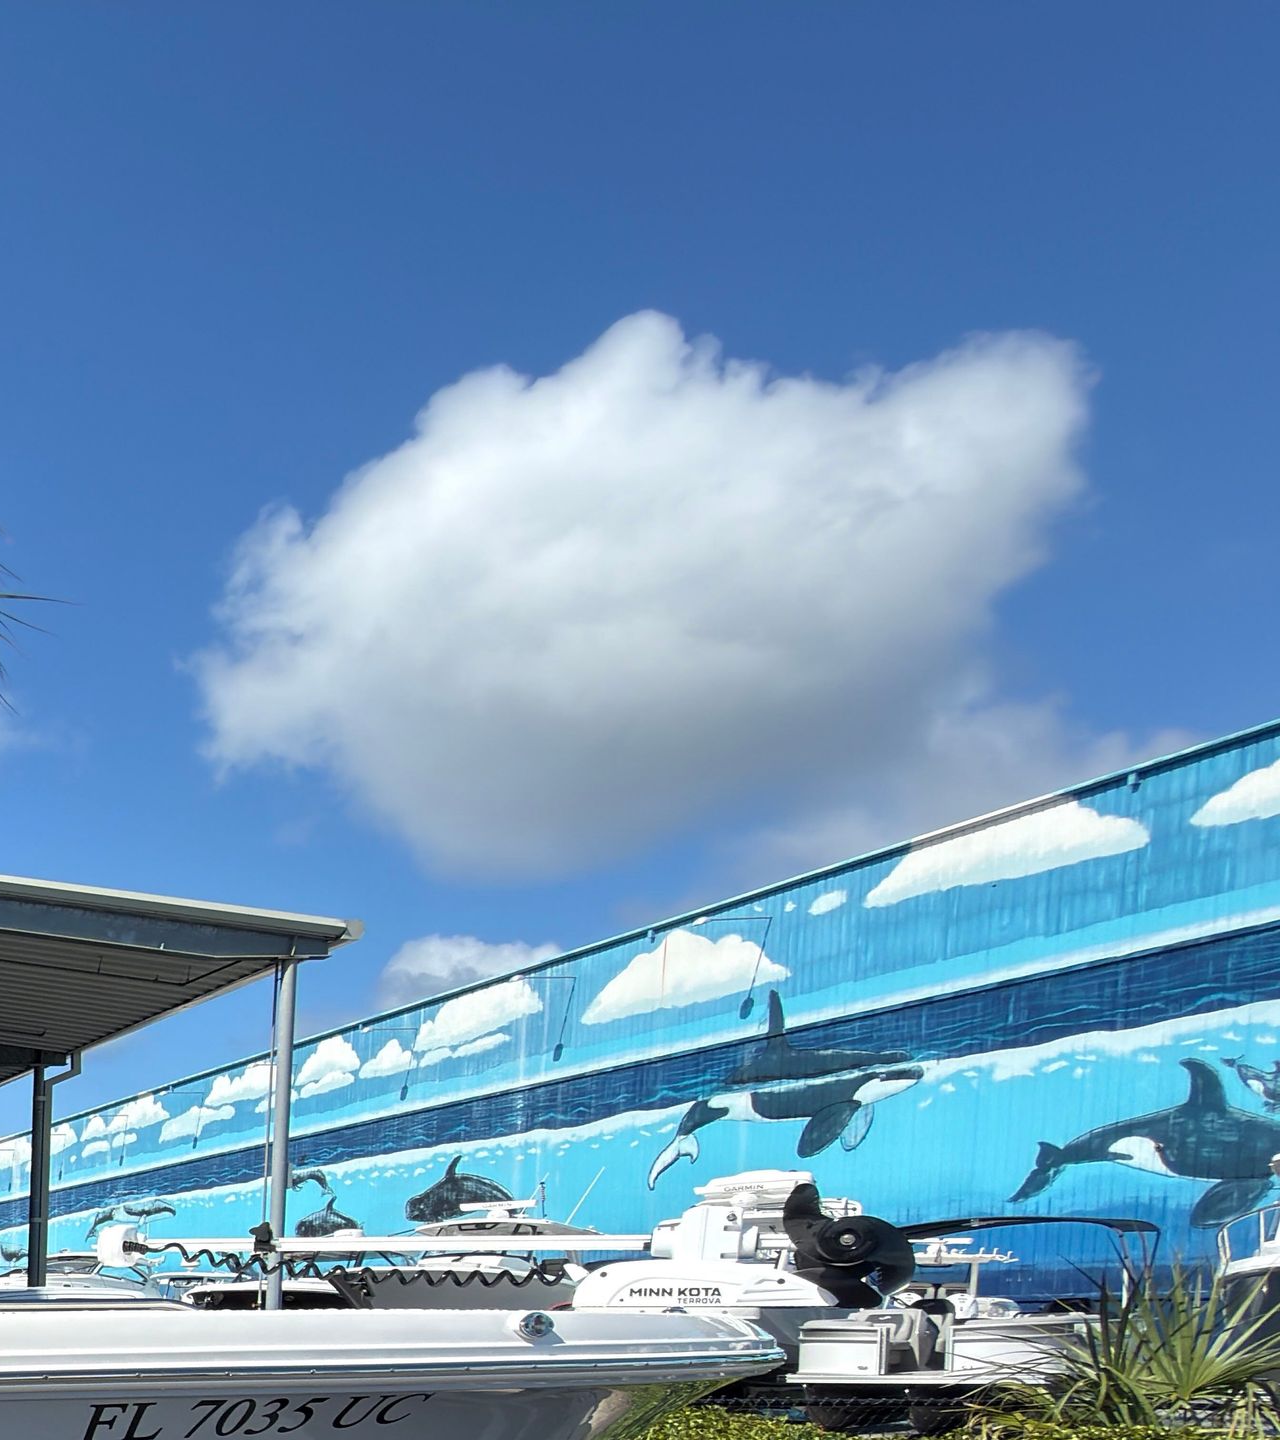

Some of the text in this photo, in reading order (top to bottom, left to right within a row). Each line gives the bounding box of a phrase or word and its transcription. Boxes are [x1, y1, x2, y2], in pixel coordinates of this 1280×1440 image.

[723, 1184, 764, 1192] GARMIN
[629, 1288, 722, 1297] MINN KOTA
[184, 1397, 331, 1438] 7035
[332, 1391, 436, 1429] UC
